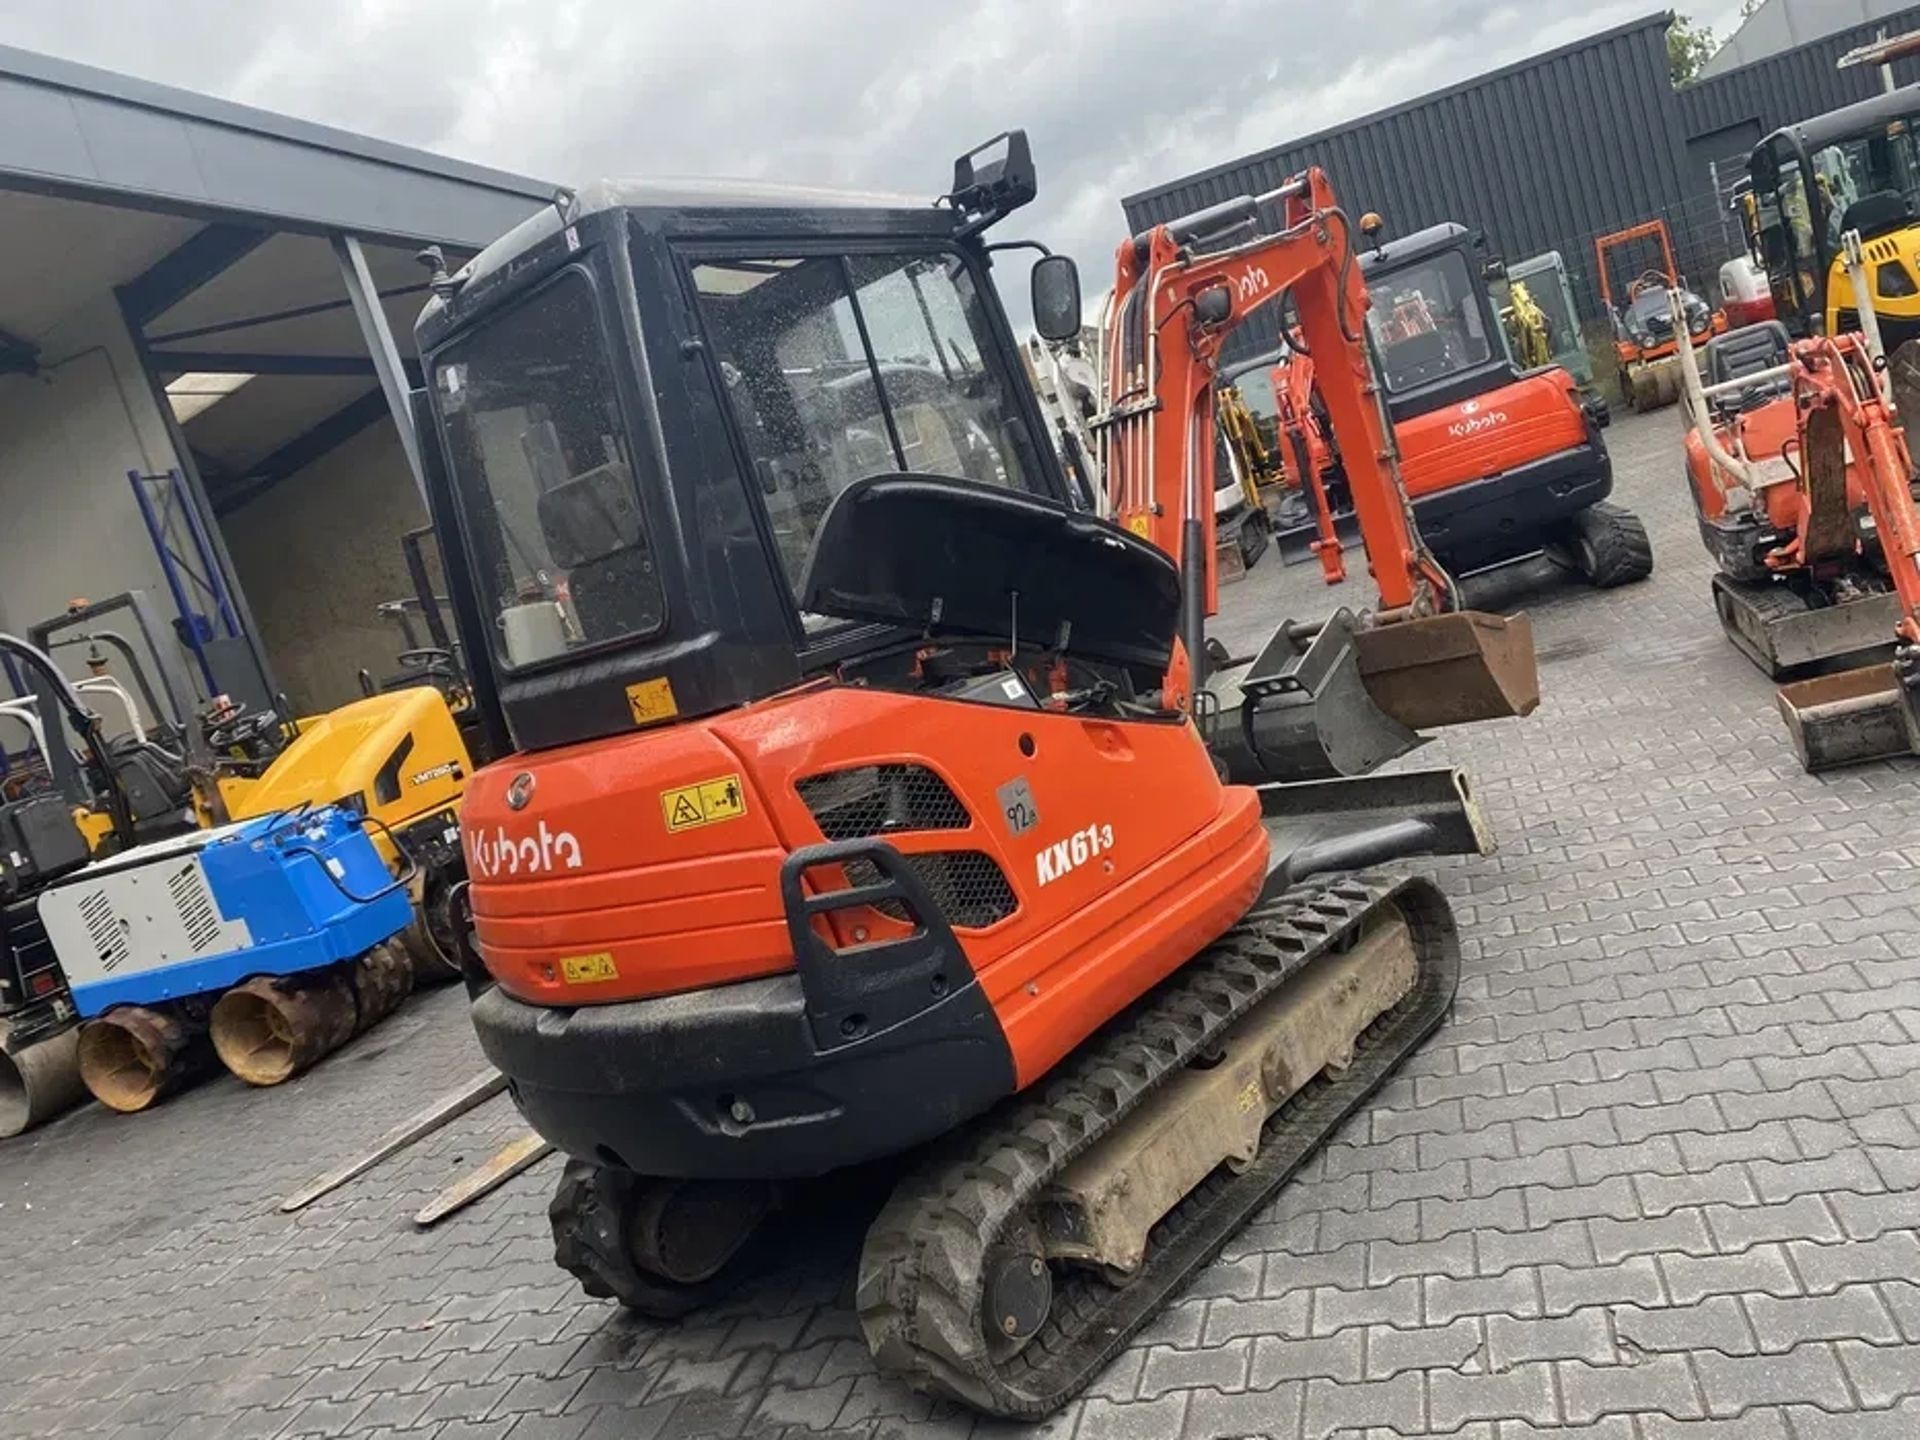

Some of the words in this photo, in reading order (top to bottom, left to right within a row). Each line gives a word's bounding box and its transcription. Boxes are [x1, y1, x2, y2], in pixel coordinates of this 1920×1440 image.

[1448, 411, 1508, 437] Kubota
[469, 820, 582, 877] Kubota
[1036, 823, 1114, 887] KX61-3
